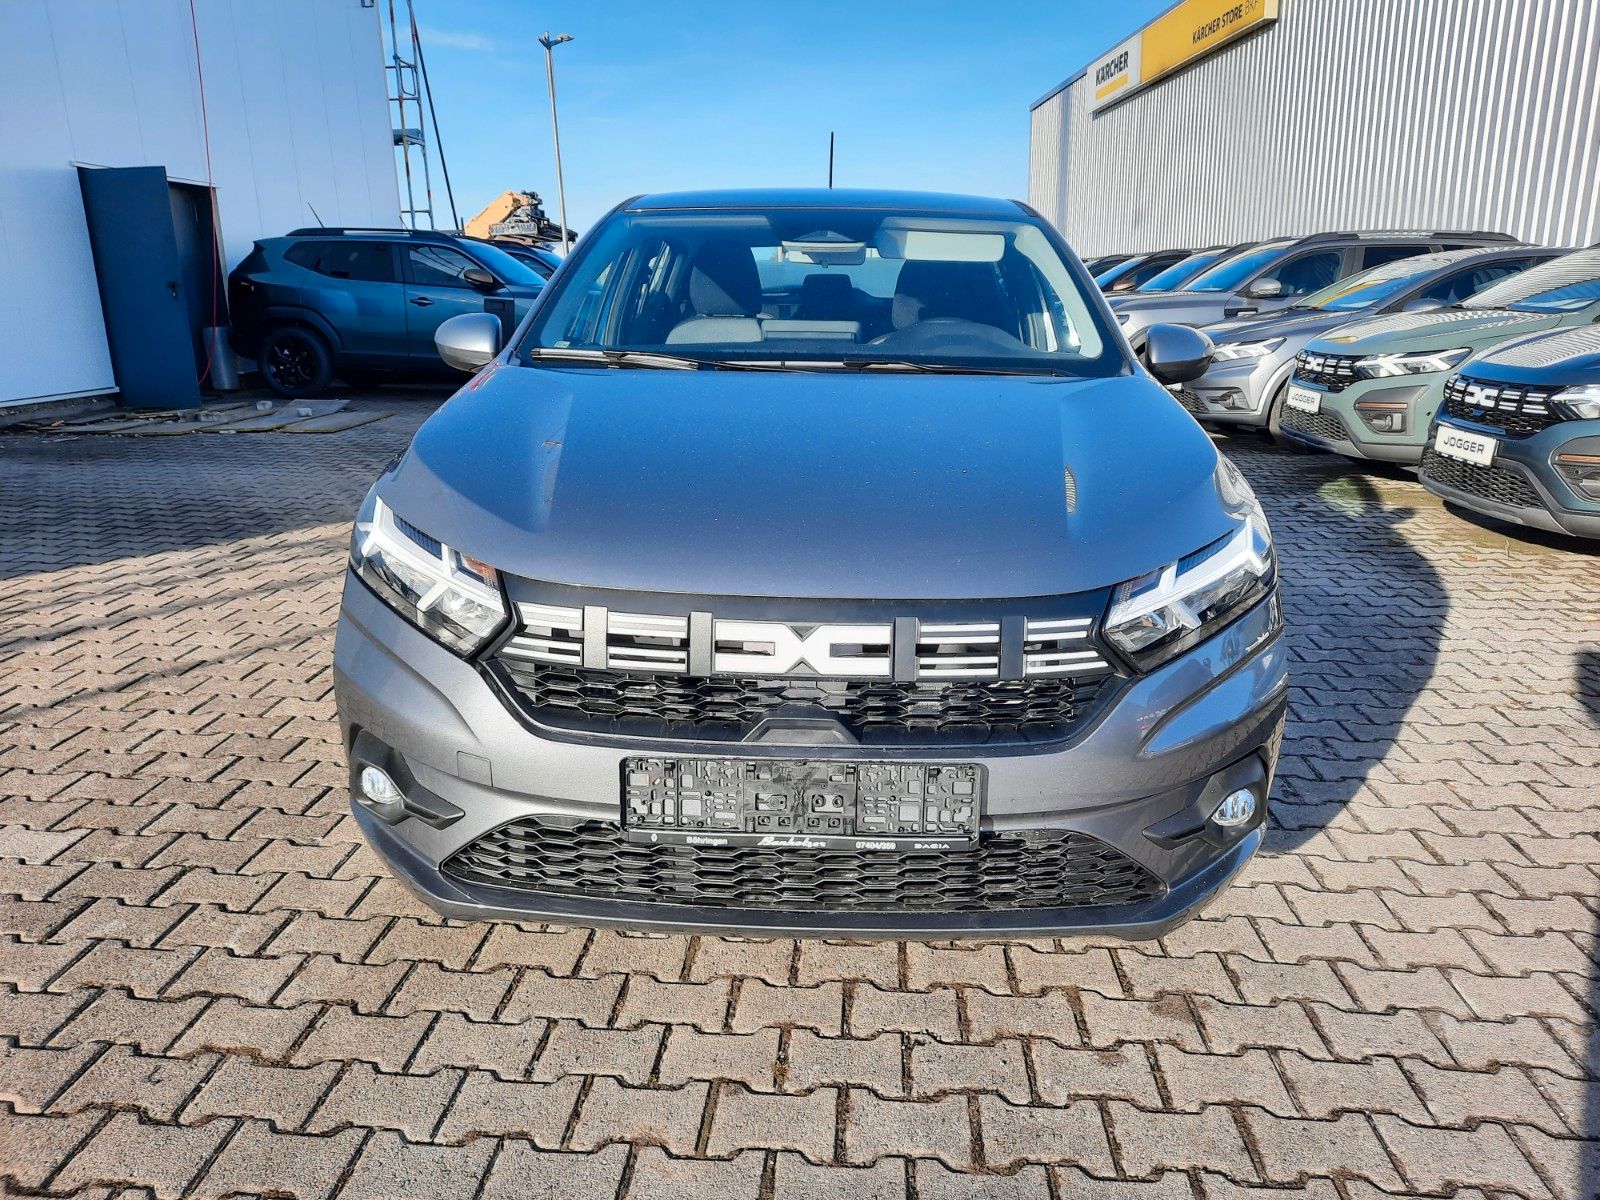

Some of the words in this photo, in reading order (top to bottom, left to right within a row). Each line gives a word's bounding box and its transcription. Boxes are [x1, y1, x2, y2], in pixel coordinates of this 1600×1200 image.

[1192, 18, 1220, 44] KÄRCHER
[1221, 4, 1243, 28] STORE
[1095, 51, 1129, 86] KÄRCHER
[1292, 393, 1316, 404] JOGGER
[1443, 435, 1485, 453] JOGGER
[686, 836, 728, 846] Böhringen
